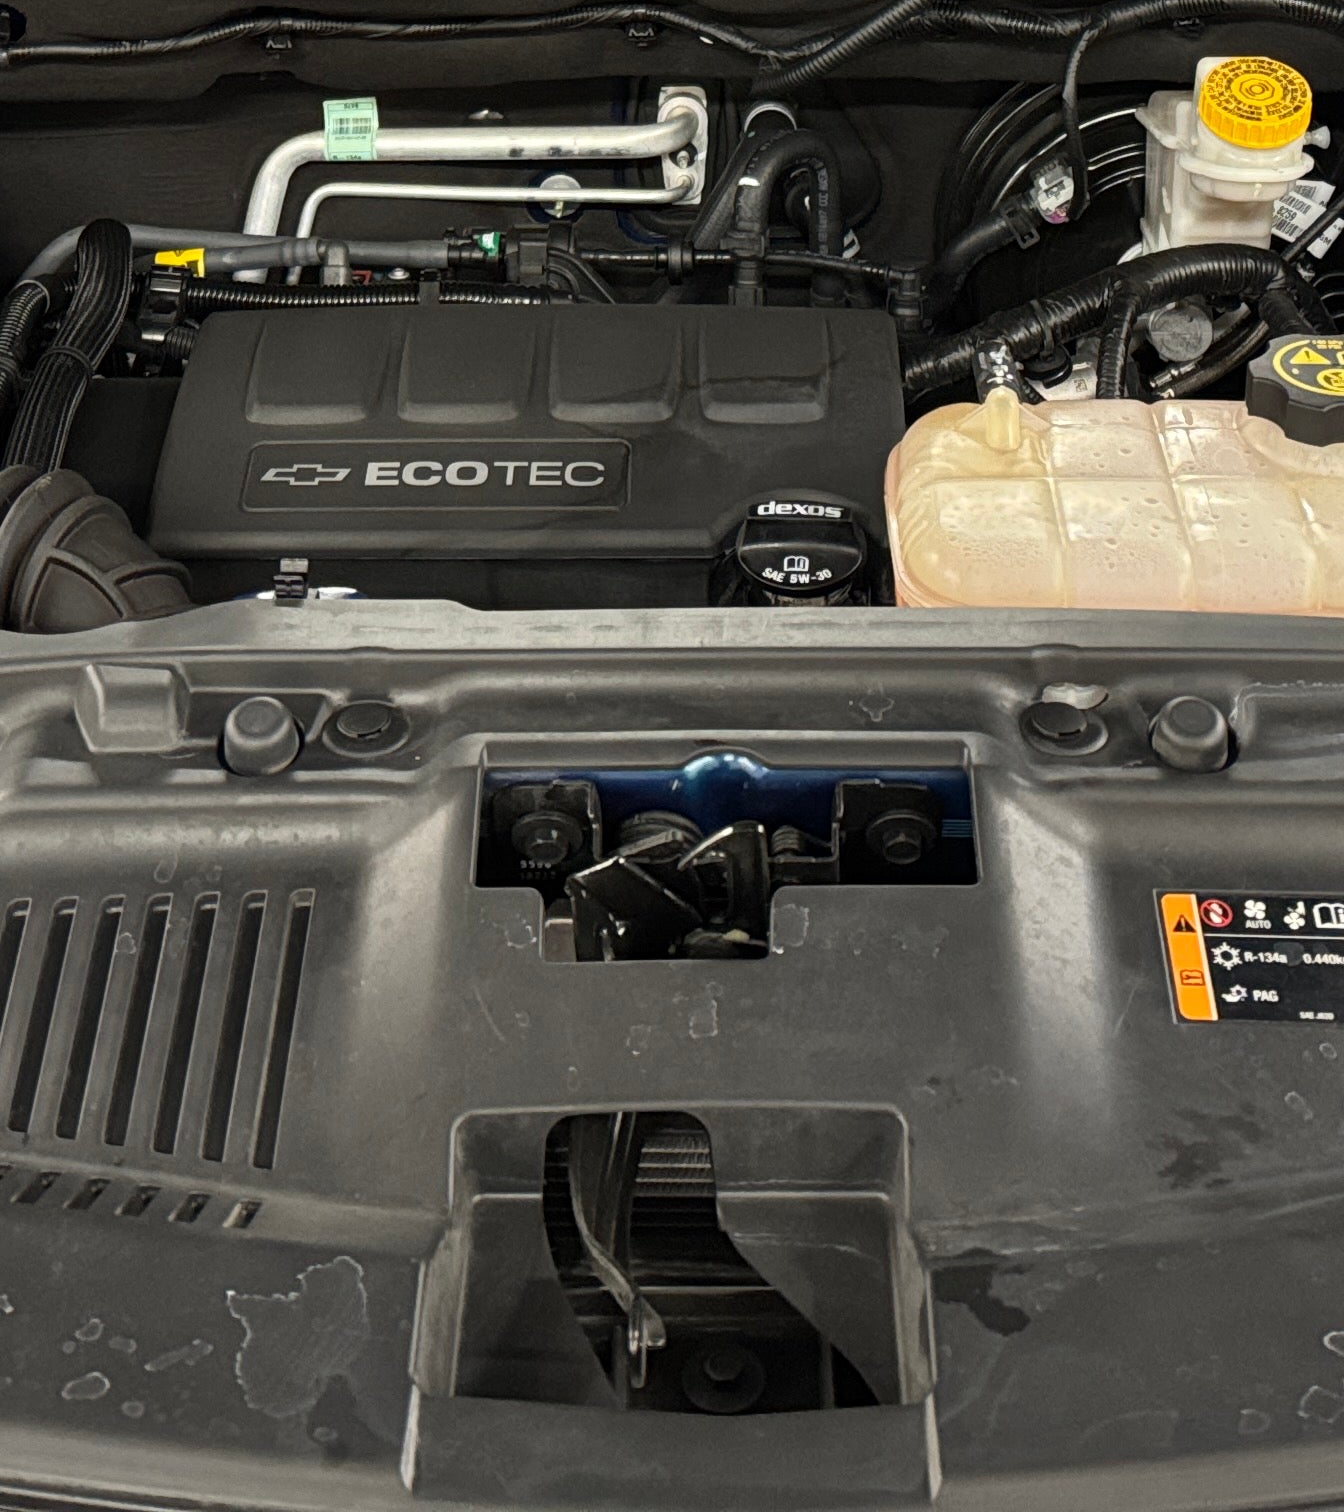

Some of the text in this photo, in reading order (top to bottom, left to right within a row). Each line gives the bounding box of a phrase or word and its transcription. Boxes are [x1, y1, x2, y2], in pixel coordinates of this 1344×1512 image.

[364, 461, 605, 487] ECOTEC
[757, 500, 845, 519] dexos
[762, 567, 833, 584] SAE 5W-30
[1245, 919, 1272, 929] AUTO
[1243, 951, 1288, 964] R-134a
[1252, 989, 1279, 1003] PAG
